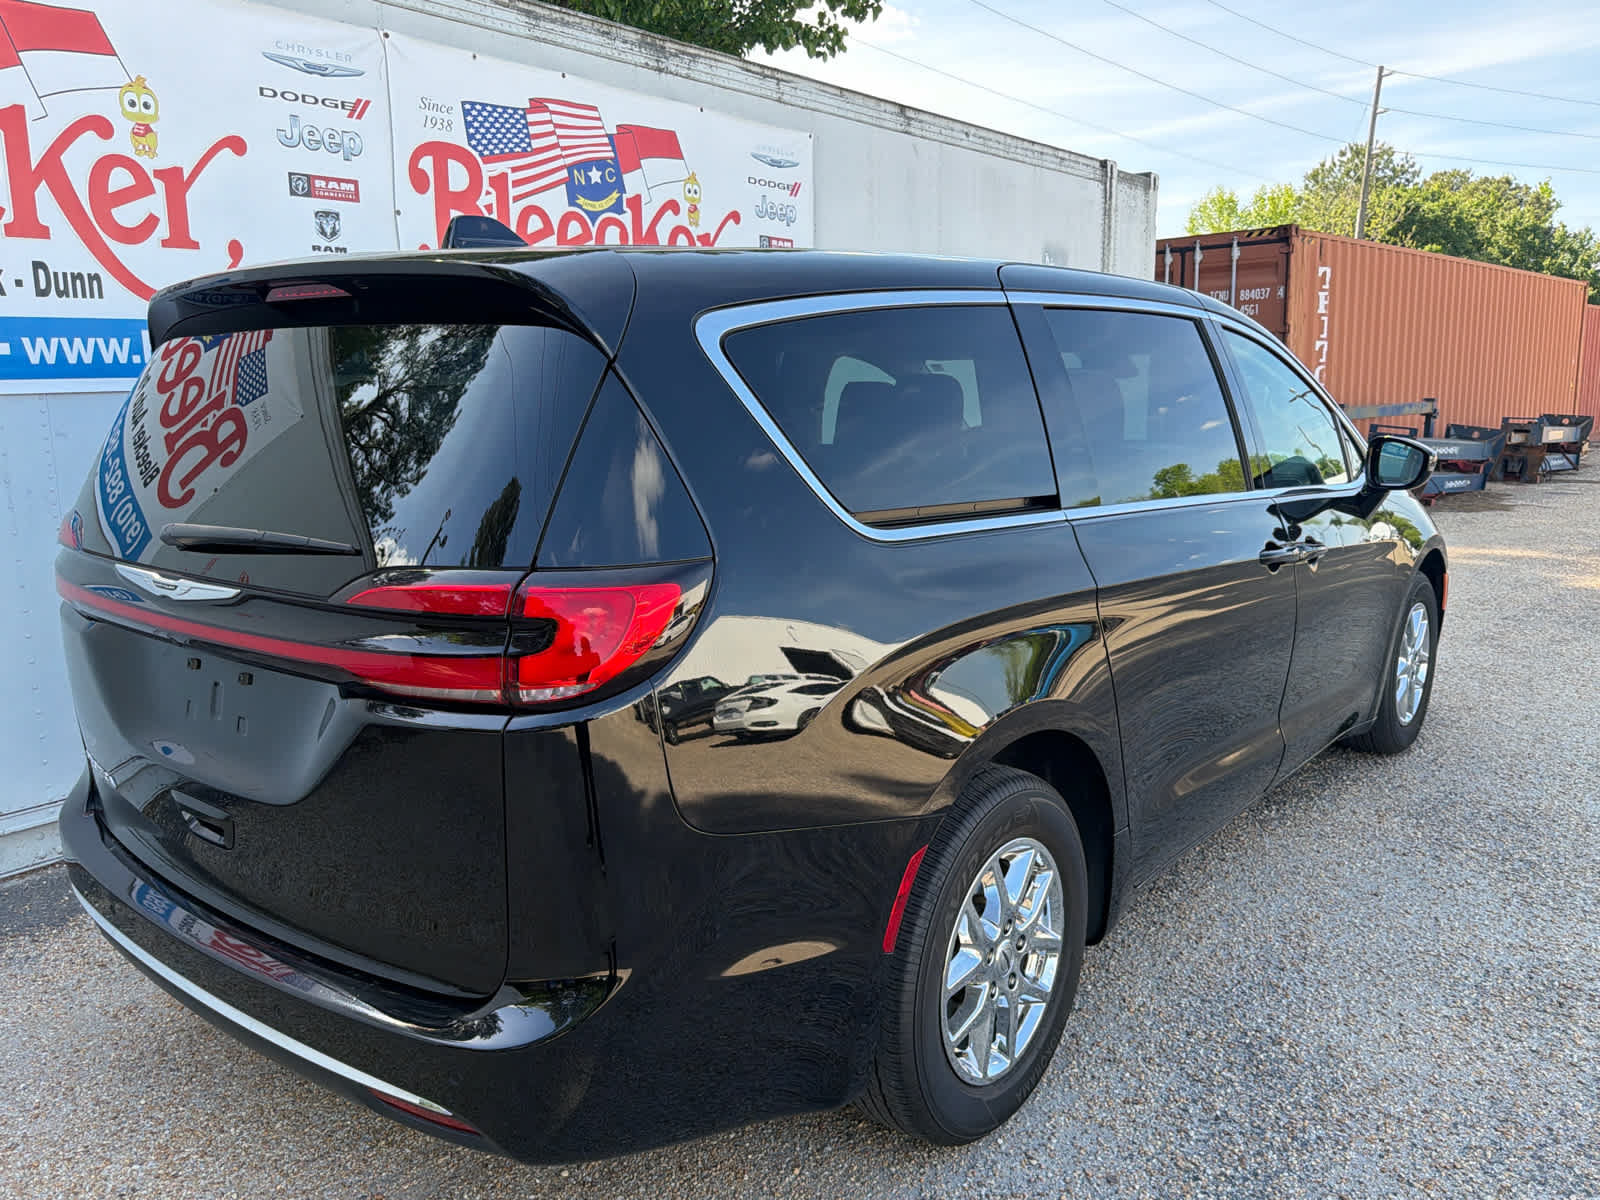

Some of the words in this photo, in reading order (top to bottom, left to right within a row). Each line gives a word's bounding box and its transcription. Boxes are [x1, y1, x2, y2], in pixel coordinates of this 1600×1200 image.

[274, 40, 353, 63] CHRYSLER
[258, 86, 359, 113] DODGE
[418, 95, 454, 115] Since
[423, 114, 454, 133] 1938
[276, 114, 363, 162] Jeep
[313, 178, 356, 192] RAM
[747, 176, 795, 192] DODGE
[754, 194, 798, 227] Jeep
[311, 244, 348, 254] RAM
[32, 260, 104, 299] Dunn
[1239, 287, 1271, 302] 884037
